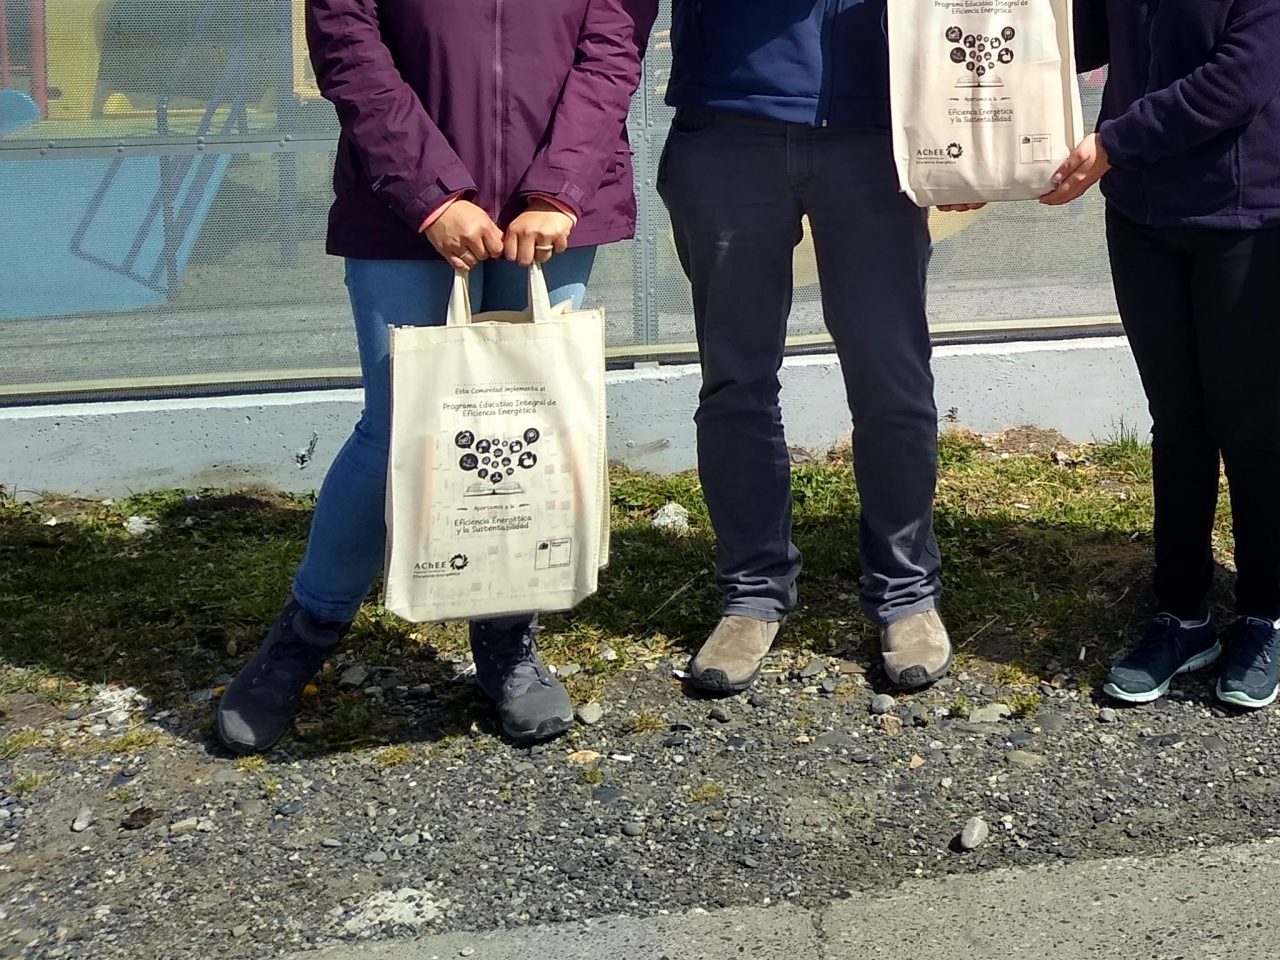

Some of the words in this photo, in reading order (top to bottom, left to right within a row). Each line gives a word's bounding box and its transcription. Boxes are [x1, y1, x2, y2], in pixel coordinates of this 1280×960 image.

[442, 402, 477, 411] Programa
[479, 401, 514, 409] Educativo
[454, 518, 490, 527] Eficiencia
[471, 522, 529, 533] Sustentabilidad
[413, 561, 447, 570] AChEE
